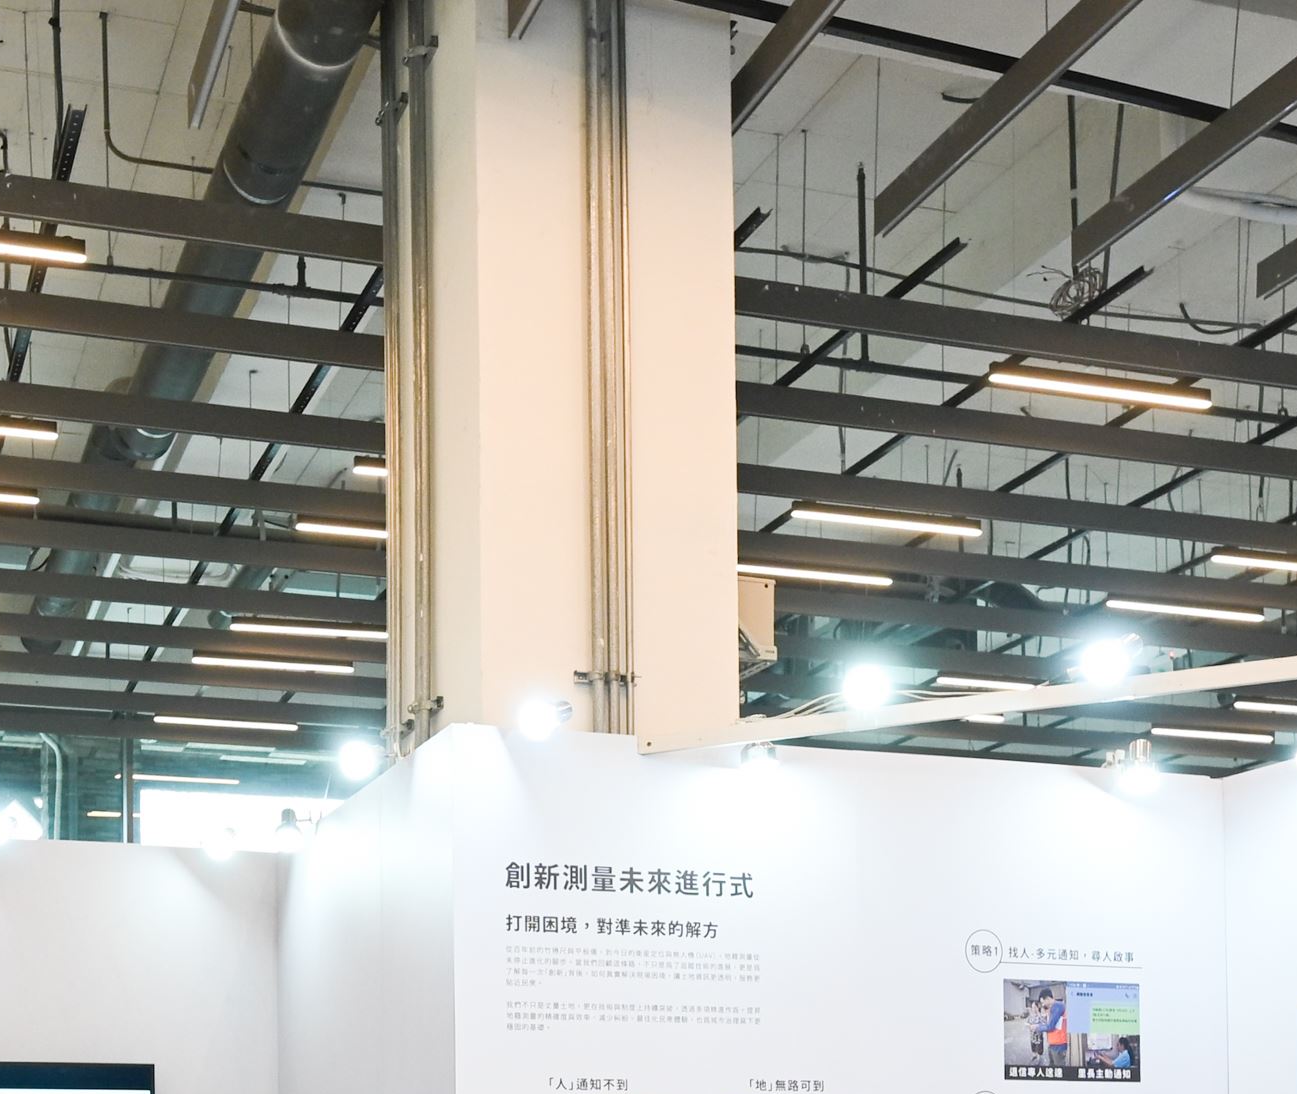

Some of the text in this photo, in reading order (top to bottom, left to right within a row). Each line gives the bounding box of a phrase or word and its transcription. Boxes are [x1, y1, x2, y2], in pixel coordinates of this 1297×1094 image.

[505, 862, 754, 898] 創新測量未來進行式
[505, 914, 719, 939] 打開困境，對準未來的解方
[971, 945, 998, 957] 策略1
[548, 1078, 628, 1091] 「人」通知不到
[748, 1078, 825, 1092] 「地」無路可到
